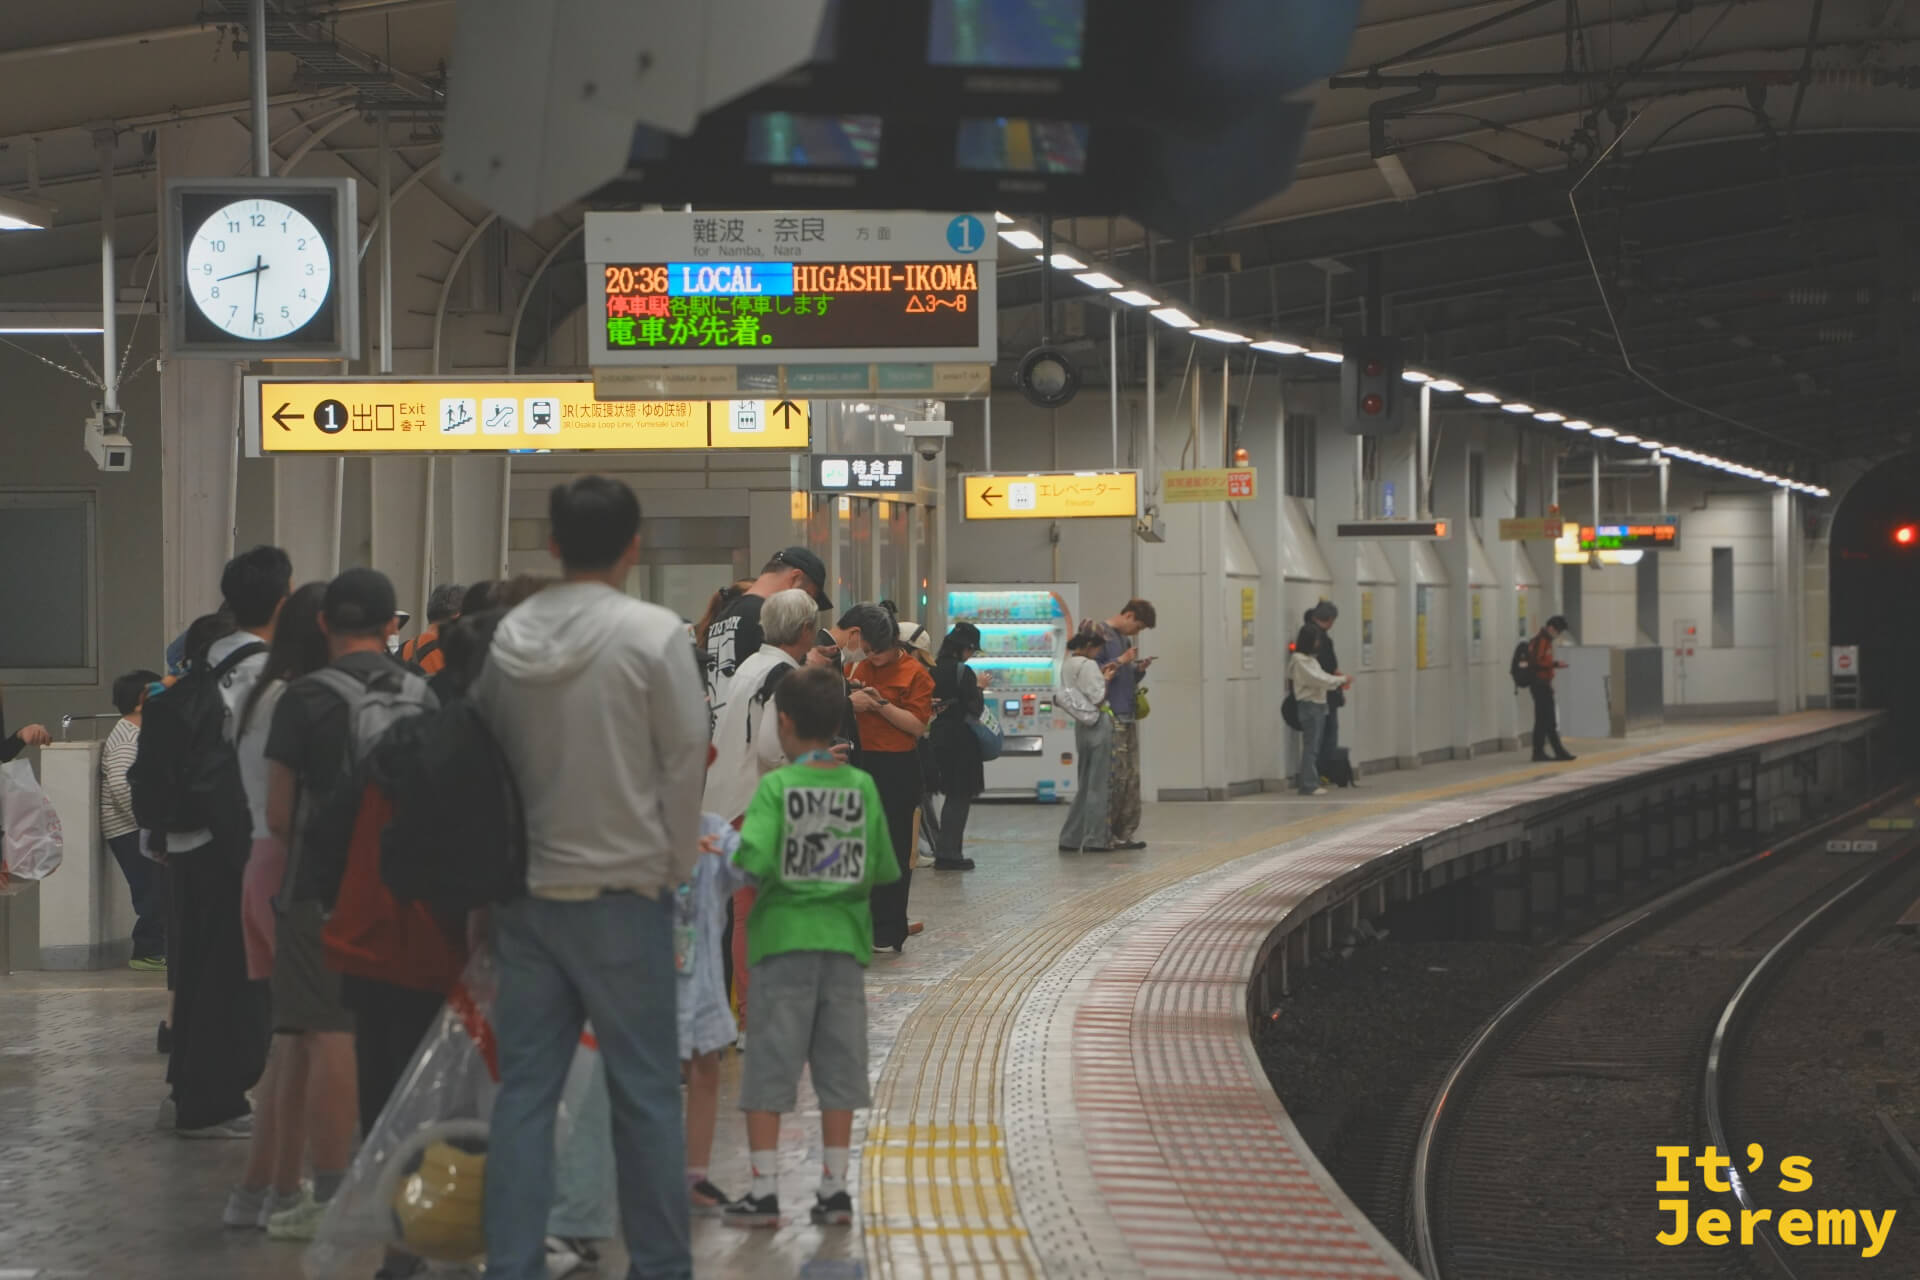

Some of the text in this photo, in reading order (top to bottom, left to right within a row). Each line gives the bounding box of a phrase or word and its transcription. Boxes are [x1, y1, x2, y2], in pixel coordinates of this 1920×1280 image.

[227, 221, 240, 233] 11
[250, 215, 265, 227] 12
[281, 221, 288, 233] 1
[957, 218, 975, 251] 1
[210, 240, 225, 252] 10
[297, 239, 306, 251] 2
[693, 245, 802, 258] for Namba, Nara
[203, 264, 213, 276] 9
[305, 264, 314, 276] 3
[606, 264, 977, 293] 20:36 LOCAL HIGASHI-IKOMA
[211, 286, 220, 299] 8
[298, 288, 307, 300] 4
[229, 306, 238, 317] 7
[281, 306, 289, 318] 5
[255, 313, 264, 325] 6
[607, 316, 773, 346] 電車が先着。
[400, 403, 426, 415] Exit
[353, 403, 395, 432] 出口
[400, 420, 427, 432] 출구
[1039, 483, 1122, 497] エレベーター
